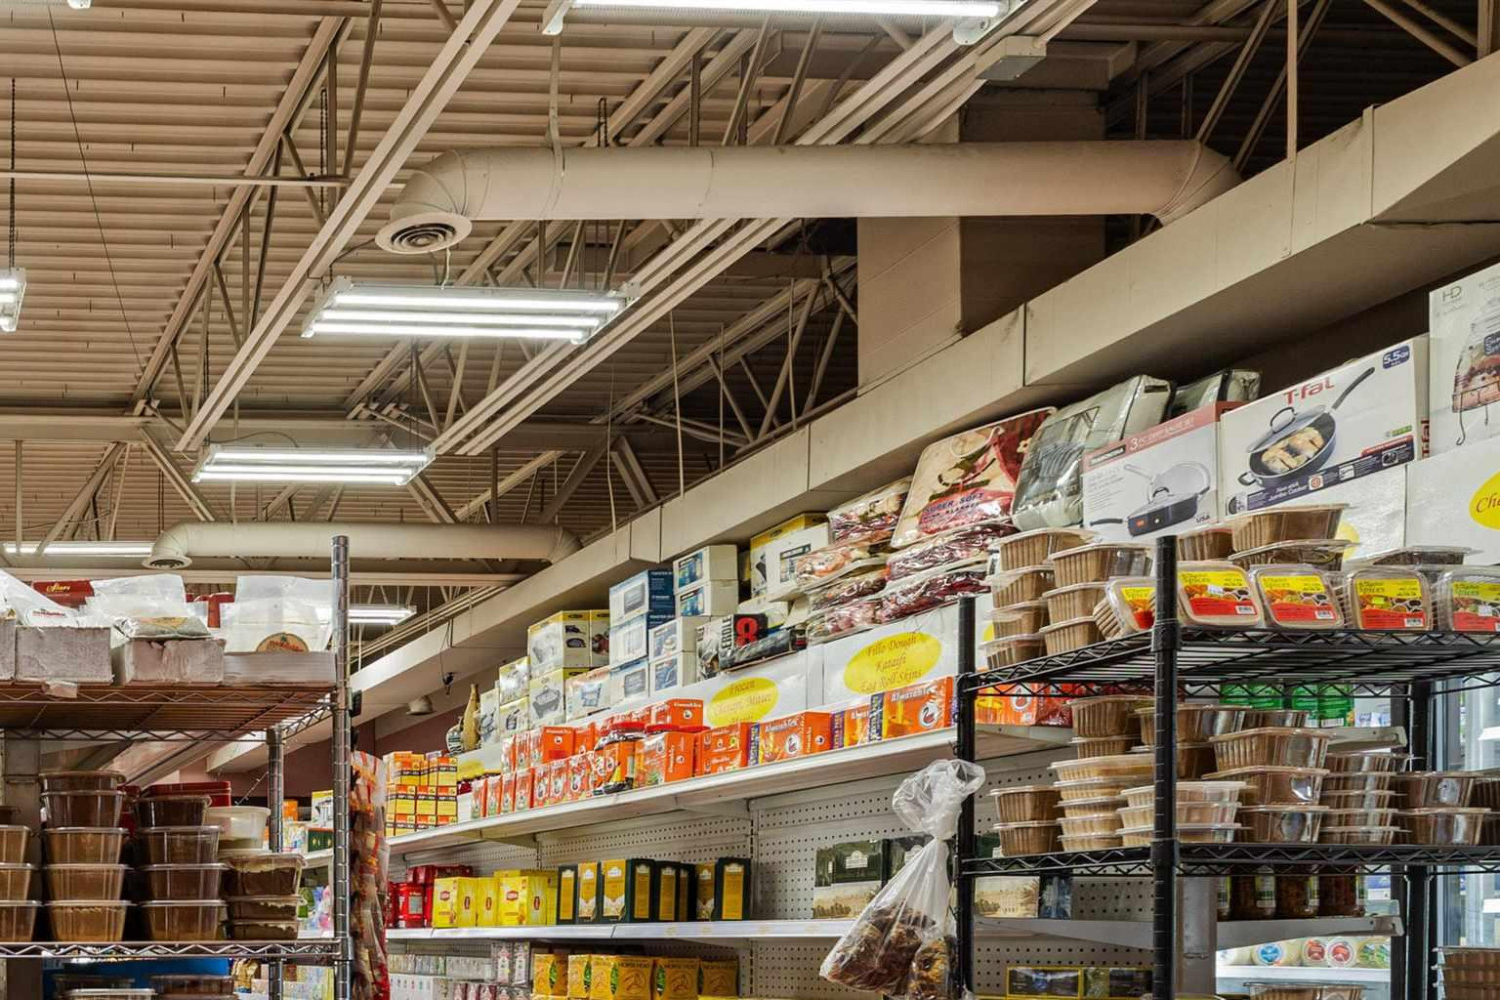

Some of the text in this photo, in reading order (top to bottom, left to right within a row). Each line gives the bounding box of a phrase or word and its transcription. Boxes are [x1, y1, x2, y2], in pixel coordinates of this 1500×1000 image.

[1284, 378, 1335, 405] T-fal
[1130, 438, 1139, 451] 3
[890, 635, 918, 652] Dough
